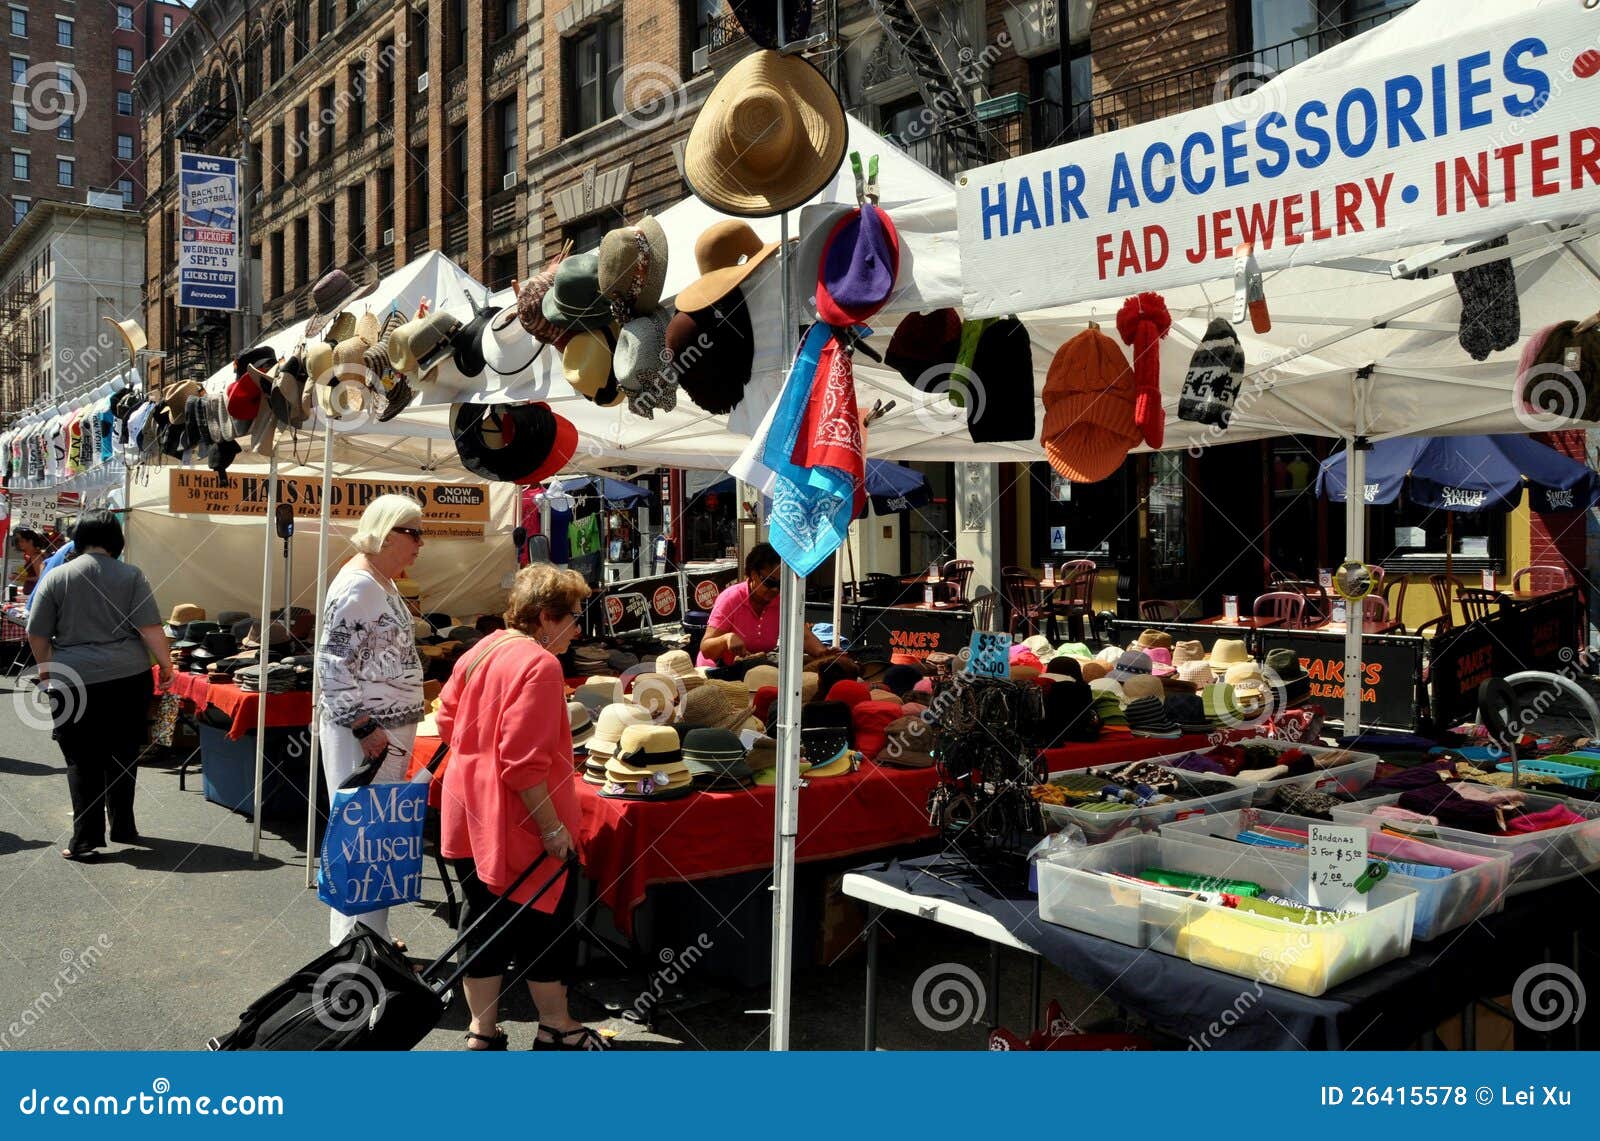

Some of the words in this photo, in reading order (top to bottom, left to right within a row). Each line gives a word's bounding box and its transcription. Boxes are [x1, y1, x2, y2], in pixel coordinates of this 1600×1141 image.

[981, 163, 1089, 241] HAIR
[1107, 37, 1551, 213] ACCESSORIES
[197, 161, 220, 171] NYC
[191, 187, 212, 198] BACK
[214, 185, 225, 193] TO
[191, 193, 232, 206] FOOTBALL
[1096, 224, 1169, 281] FAD
[1185, 172, 1395, 265] JEWELRY
[1435, 126, 1600, 217] INTER
[198, 231, 230, 242] KICKOFF
[183, 245, 235, 256] WEDNESDAY
[190, 255, 219, 266] SEPT.
[222, 257, 228, 267] 5
[184, 270, 208, 280] KICKS
[209, 272, 218, 280] IT
[219, 273, 234, 282] OFF
[190, 291, 227, 299] lenovo
[193, 474, 239, 490] Marts
[187, 488, 201, 499] 30
[203, 489, 229, 501] years
[242, 477, 298, 505] HATS
[445, 487, 472, 496] NOW
[1441, 487, 1487, 500] SAMUEL
[437, 495, 480, 504] ONLINE!
[1443, 497, 1482, 507] ADAMS
[205, 503, 230, 512] The
[235, 504, 268, 513] Lates
[298, 506, 321, 515] Hat
[332, 508, 340, 516] &
[1053, 529, 1063, 543] A
[889, 630, 940, 648] JAKE'S
[1298, 657, 1383, 685] AK'S
[367, 787, 424, 824] Met
[1312, 827, 1354, 844] Bandanas
[341, 826, 421, 864] Museu
[1311, 846, 1317, 856] 3
[1320, 848, 1334, 857] For
[372, 863, 422, 901] Art
